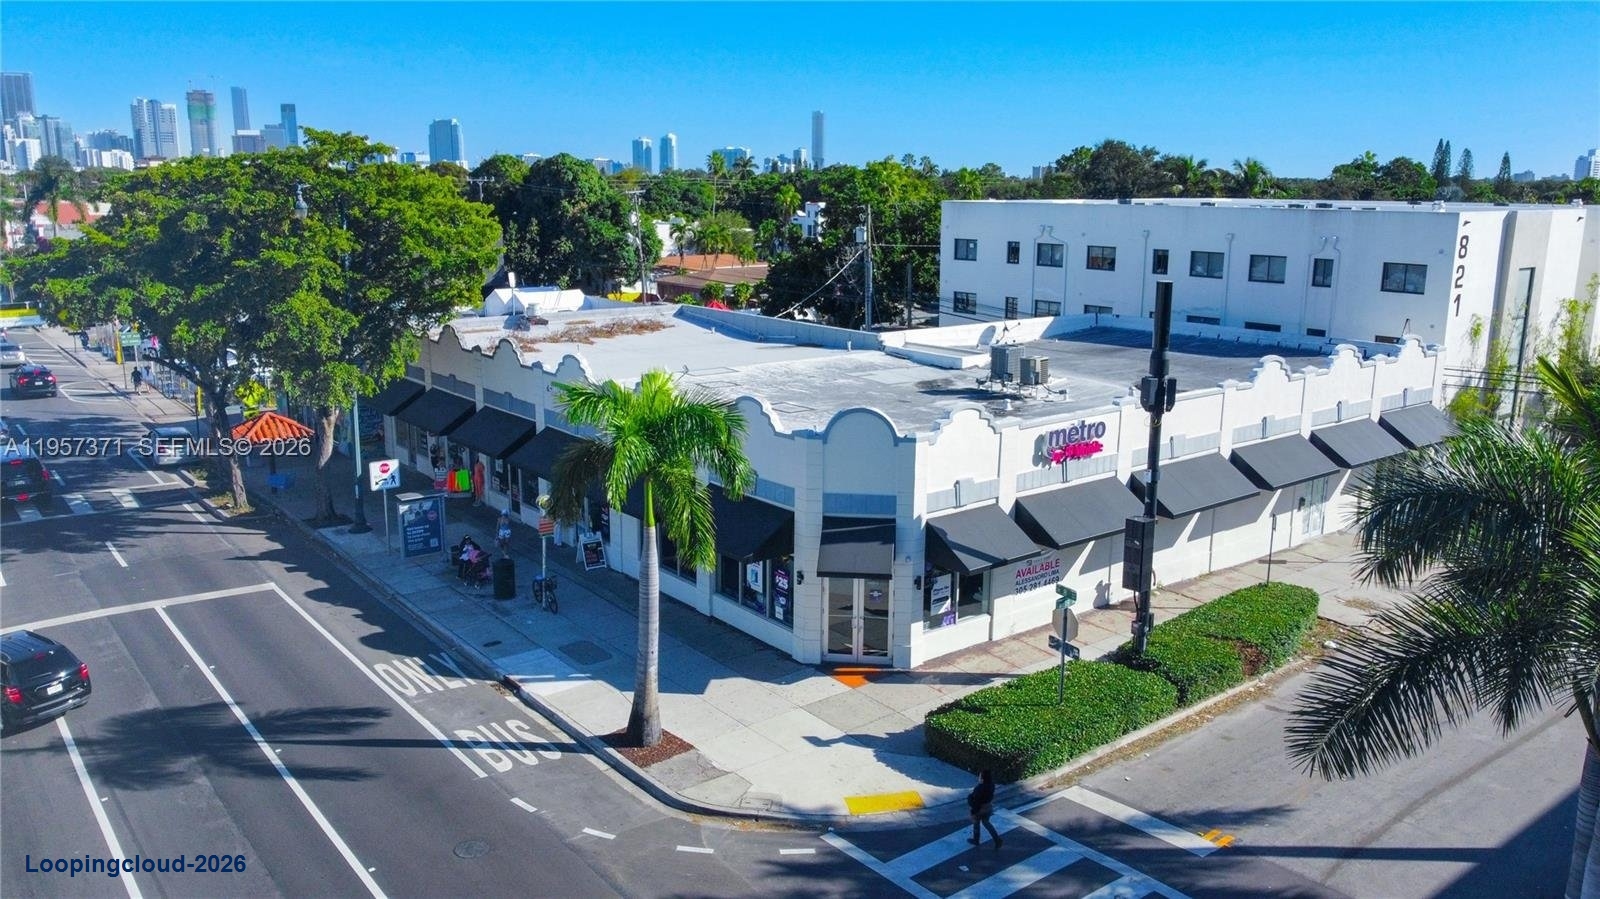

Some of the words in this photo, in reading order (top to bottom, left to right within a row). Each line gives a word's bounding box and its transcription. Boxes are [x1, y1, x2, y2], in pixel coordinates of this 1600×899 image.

[1453, 235, 1469, 318] 821
[1048, 420, 1106, 447] metro
[1015, 558, 1060, 579] AVAILABLE
[373, 652, 476, 697] ONLY
[454, 719, 562, 773] BUS
